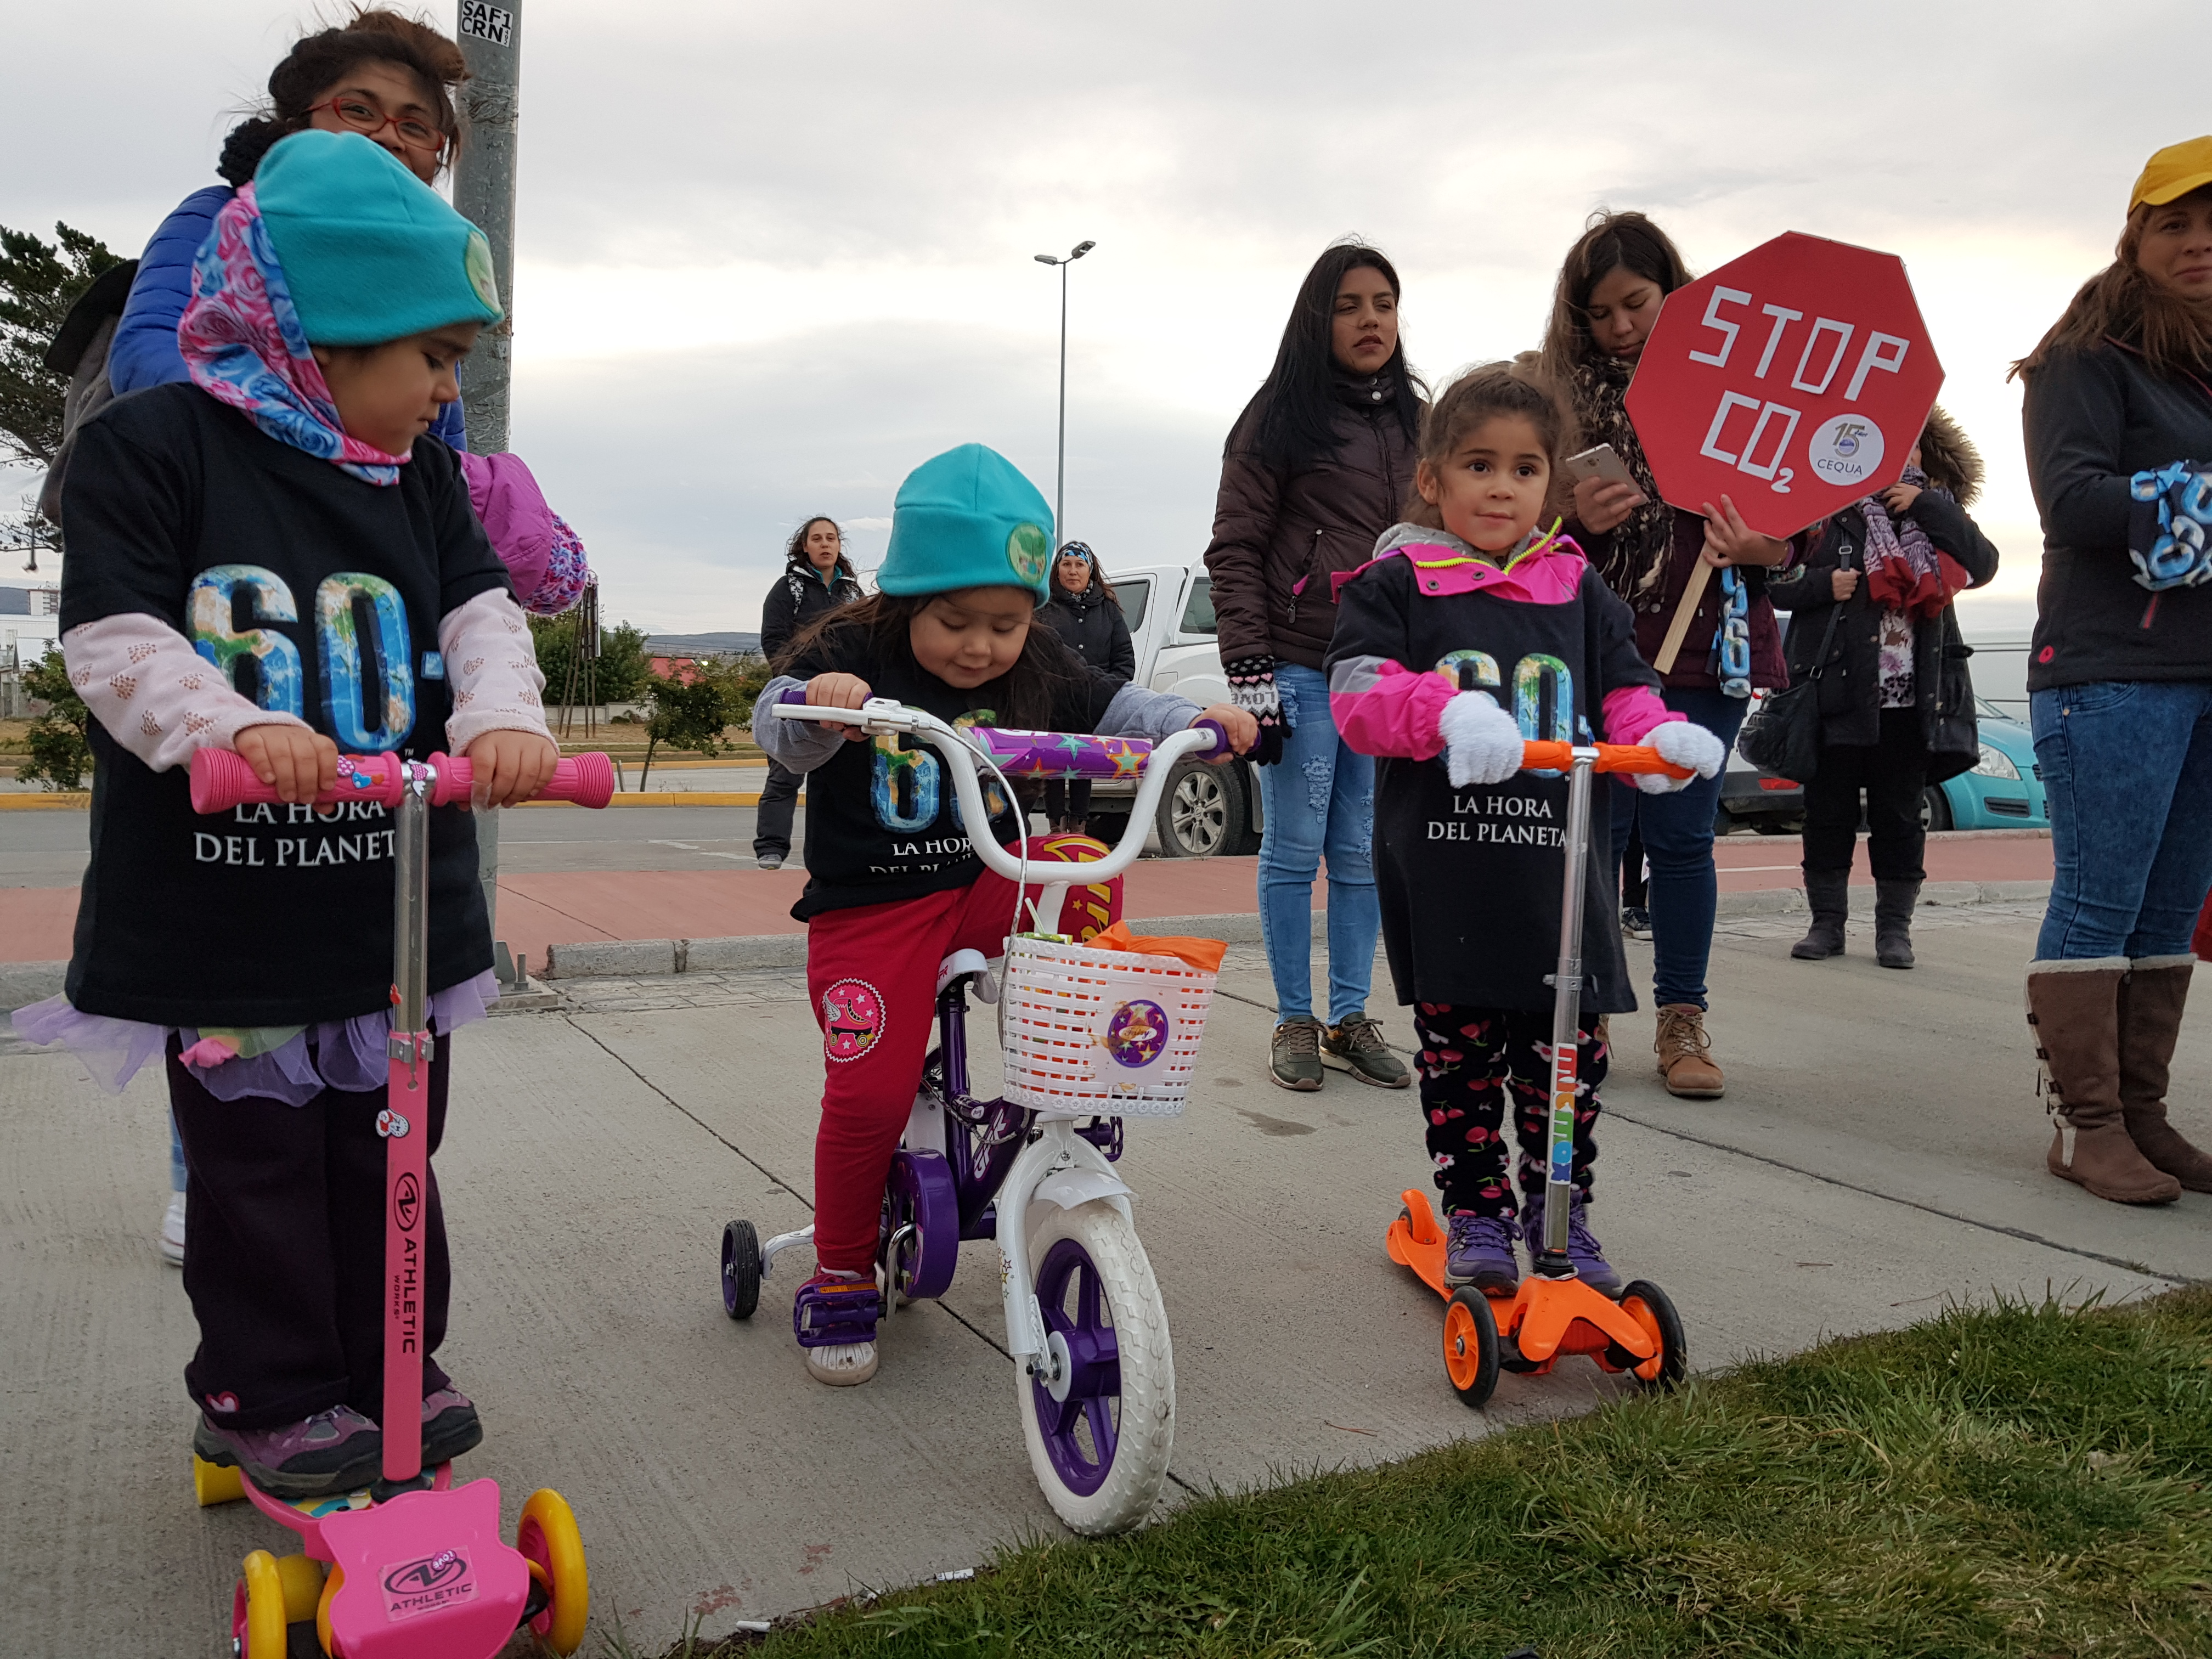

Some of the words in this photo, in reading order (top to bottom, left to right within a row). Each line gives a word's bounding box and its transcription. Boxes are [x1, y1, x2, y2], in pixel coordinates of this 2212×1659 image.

[463, 1, 511, 30] SAF1
[461, 17, 503, 43] CRN
[1689, 285, 1910, 402] STOP
[1832, 422, 1865, 458] 15
[1817, 459, 1862, 476] CEQUA
[1231, 691, 1275, 705] LOVE
[234, 802, 278, 825] LA
[1453, 795, 1480, 815] LA
[1486, 796, 1553, 819] HORA
[193, 831, 264, 867] DEL
[275, 829, 396, 867] PLANET
[891, 842, 921, 856] LA
[924, 837, 973, 855] HOR
[1427, 821, 1471, 841] DEL
[1476, 823, 1566, 848] PLANETA
[402, 1237, 417, 1354] ATHLETIC
[390, 1583, 472, 1612] ATHLETIC
